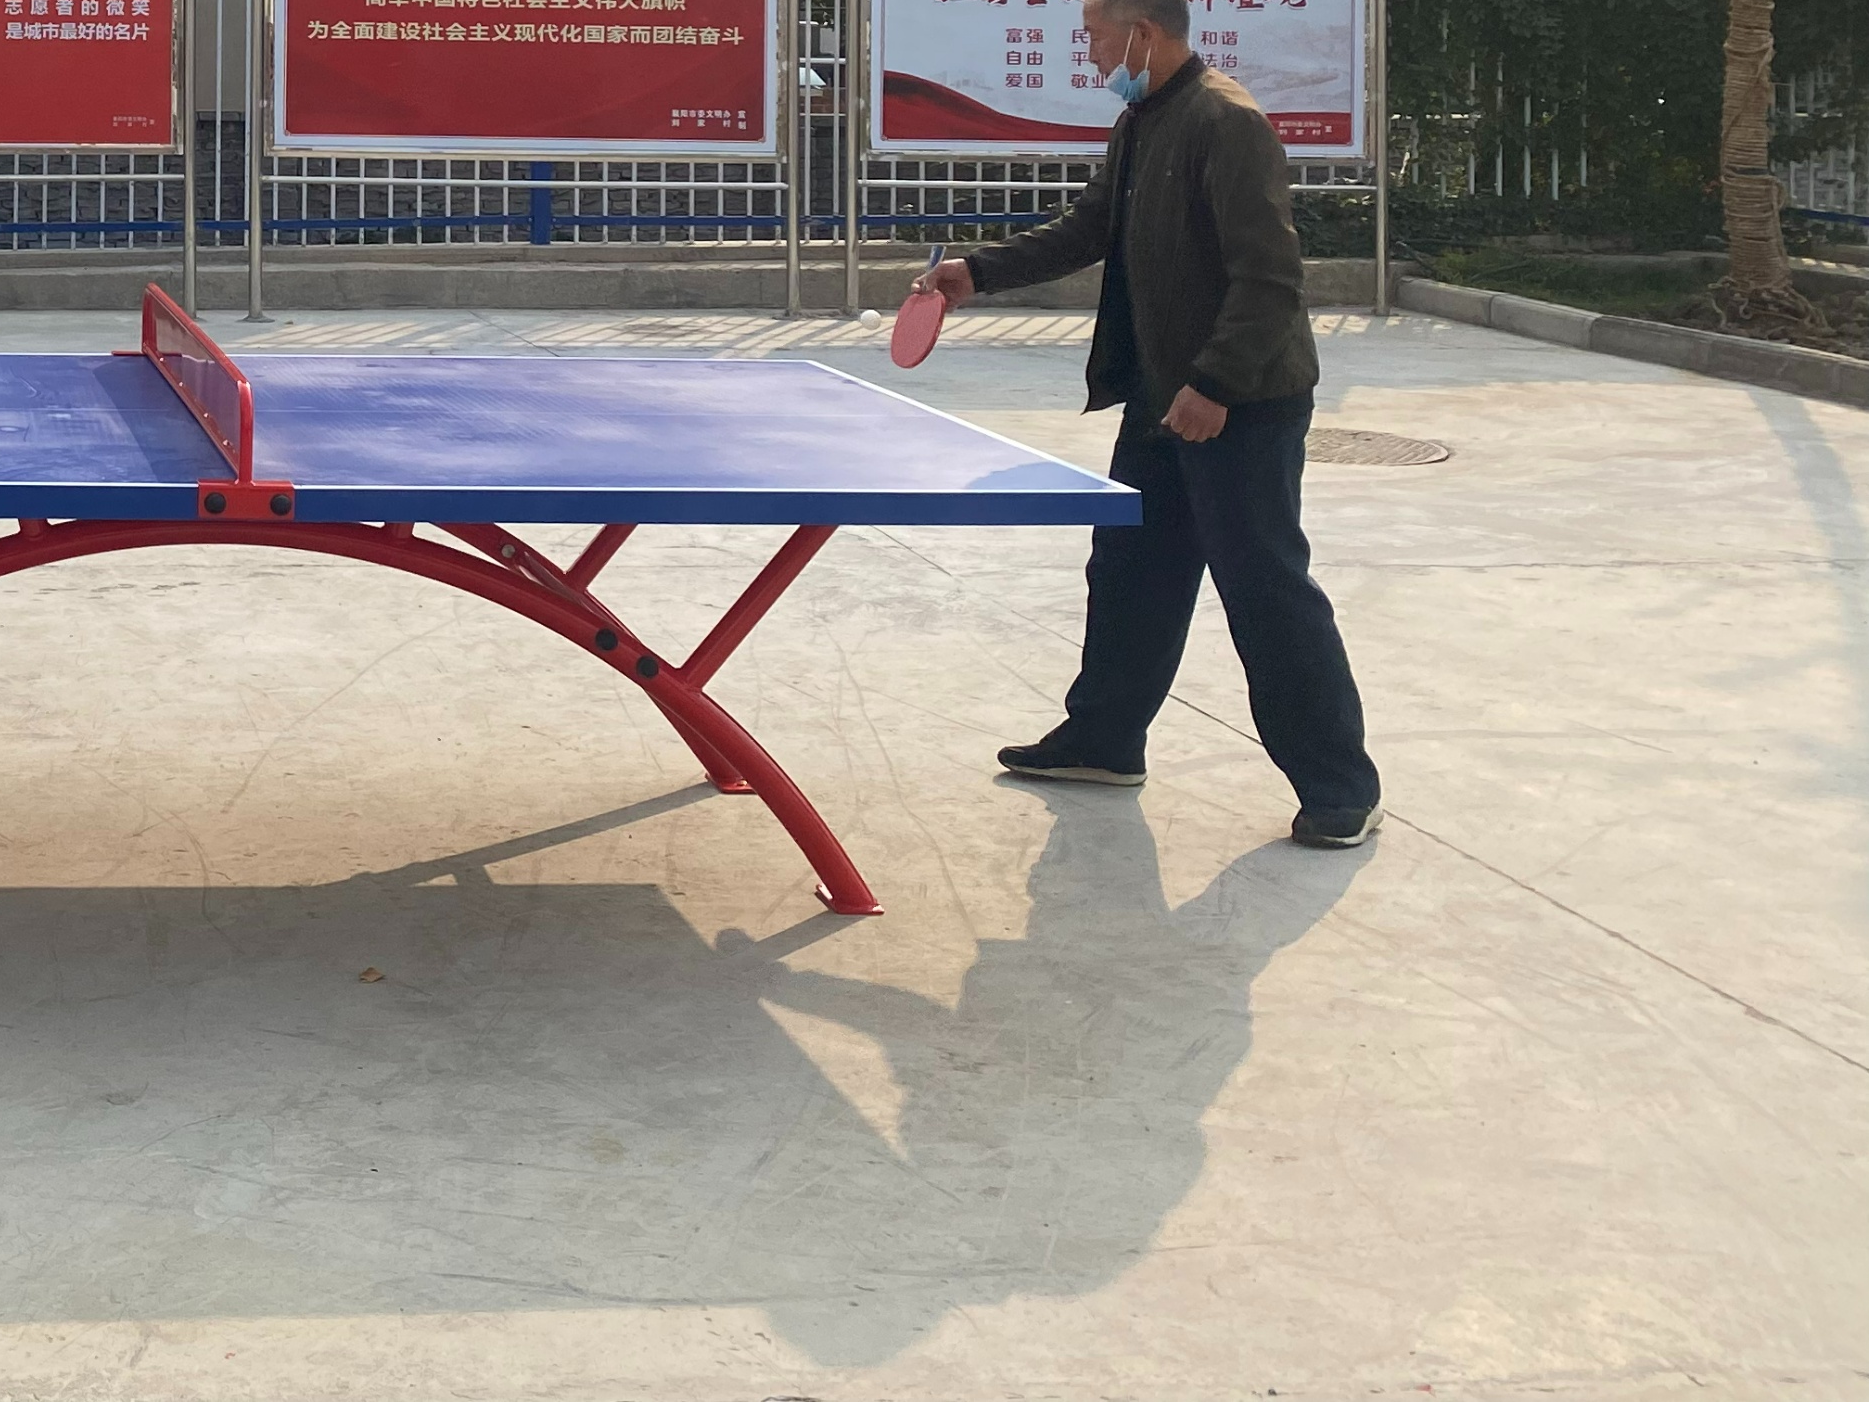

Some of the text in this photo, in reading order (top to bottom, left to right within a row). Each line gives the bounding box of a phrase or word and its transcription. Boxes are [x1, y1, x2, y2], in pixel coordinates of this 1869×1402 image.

[5, 22, 150, 40] 是城市最好的名片
[307, 20, 745, 46] 为全面建设社会主义现代化国家而团结奋斗
[1005, 28, 1044, 44] 富强
[1200, 30, 1239, 46] 和谐
[1005, 51, 1044, 66] 自由
[1201, 53, 1239, 69] 法治
[1005, 73, 1109, 89] 爱国 敬业
